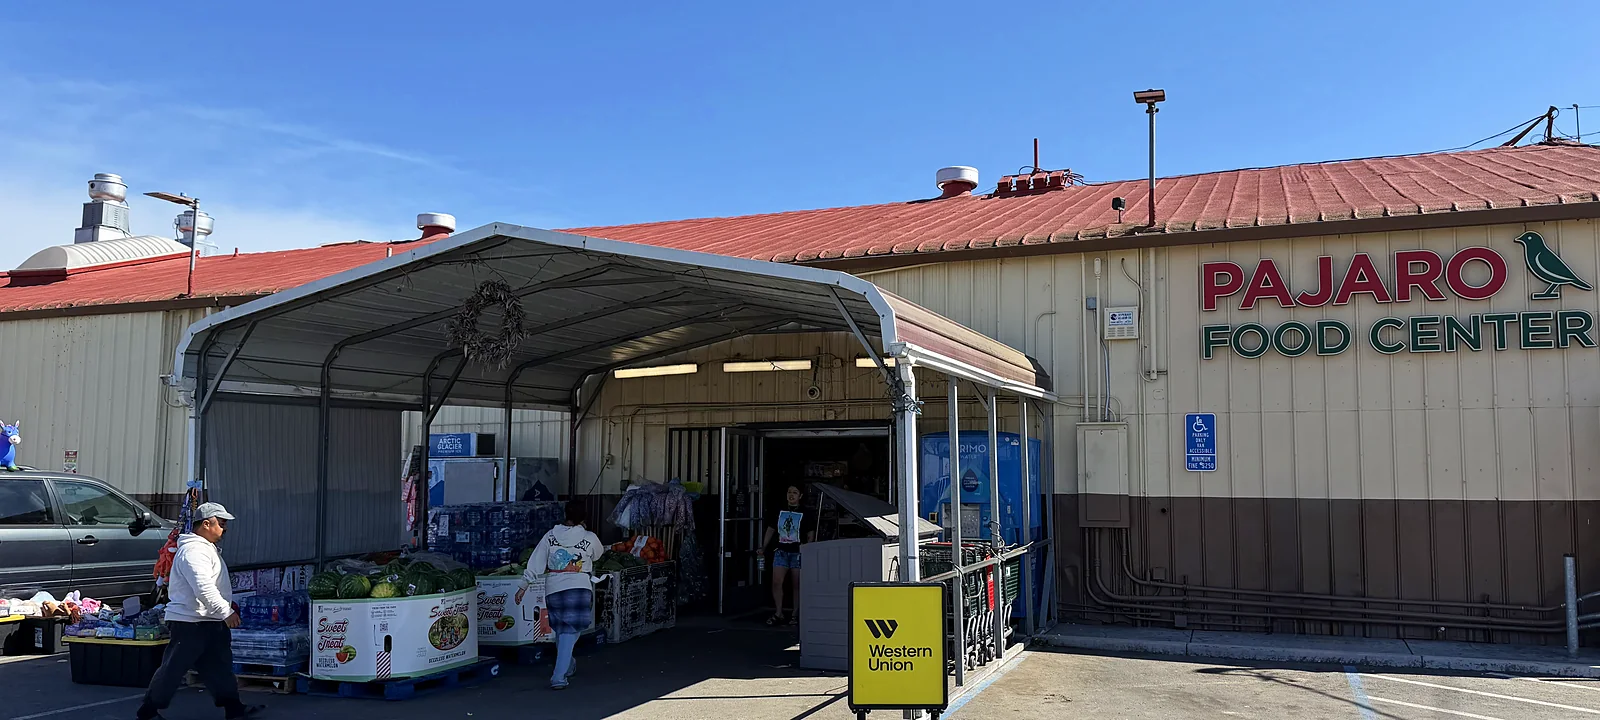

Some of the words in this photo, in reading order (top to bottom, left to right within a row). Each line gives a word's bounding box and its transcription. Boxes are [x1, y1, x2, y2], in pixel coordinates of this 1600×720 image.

[1201, 245, 1509, 312] PAJARO
[1201, 319, 1352, 360] FOOD
[1368, 309, 1598, 354] CENTER
[960, 444, 987, 453] RIMO
[477, 591, 508, 605] Sweet
[477, 606, 504, 620] Treat
[317, 617, 348, 633] Sweet
[318, 635, 345, 651] Treat
[868, 644, 932, 658] Western
[868, 658, 914, 671] Union
